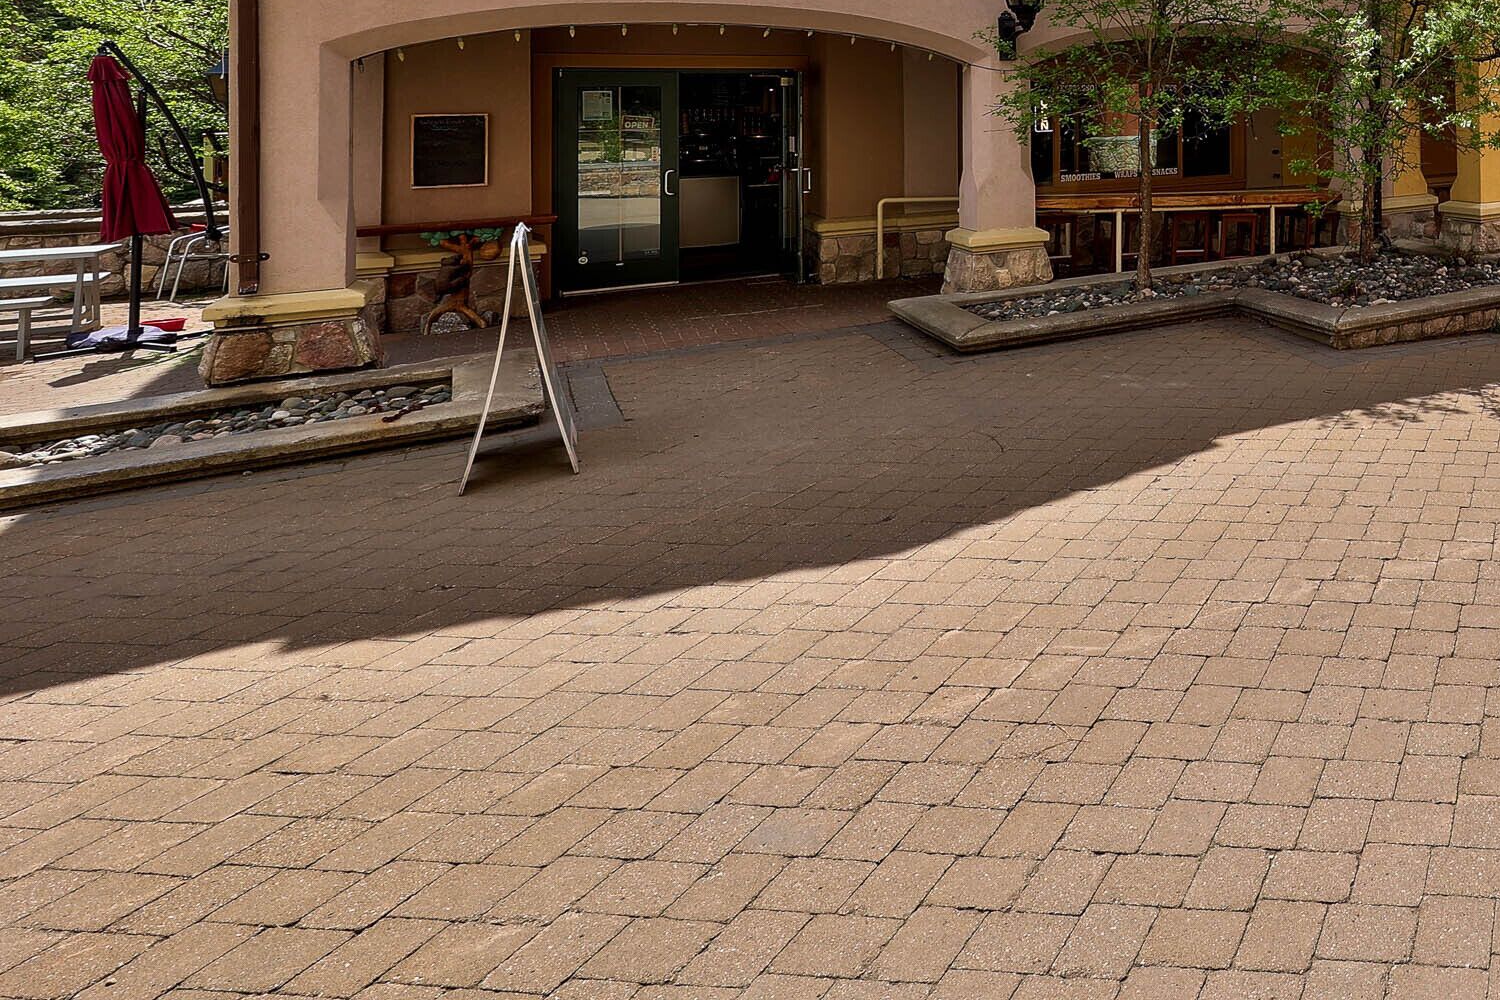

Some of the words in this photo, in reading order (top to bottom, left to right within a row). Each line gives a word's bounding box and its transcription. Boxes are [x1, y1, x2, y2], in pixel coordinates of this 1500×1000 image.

[624, 121, 649, 129] OPEN
[1060, 172, 1101, 182] SMOOTHIES
[1114, 169, 1138, 179] WRAPS
[1152, 167, 1178, 176] SNACKS
